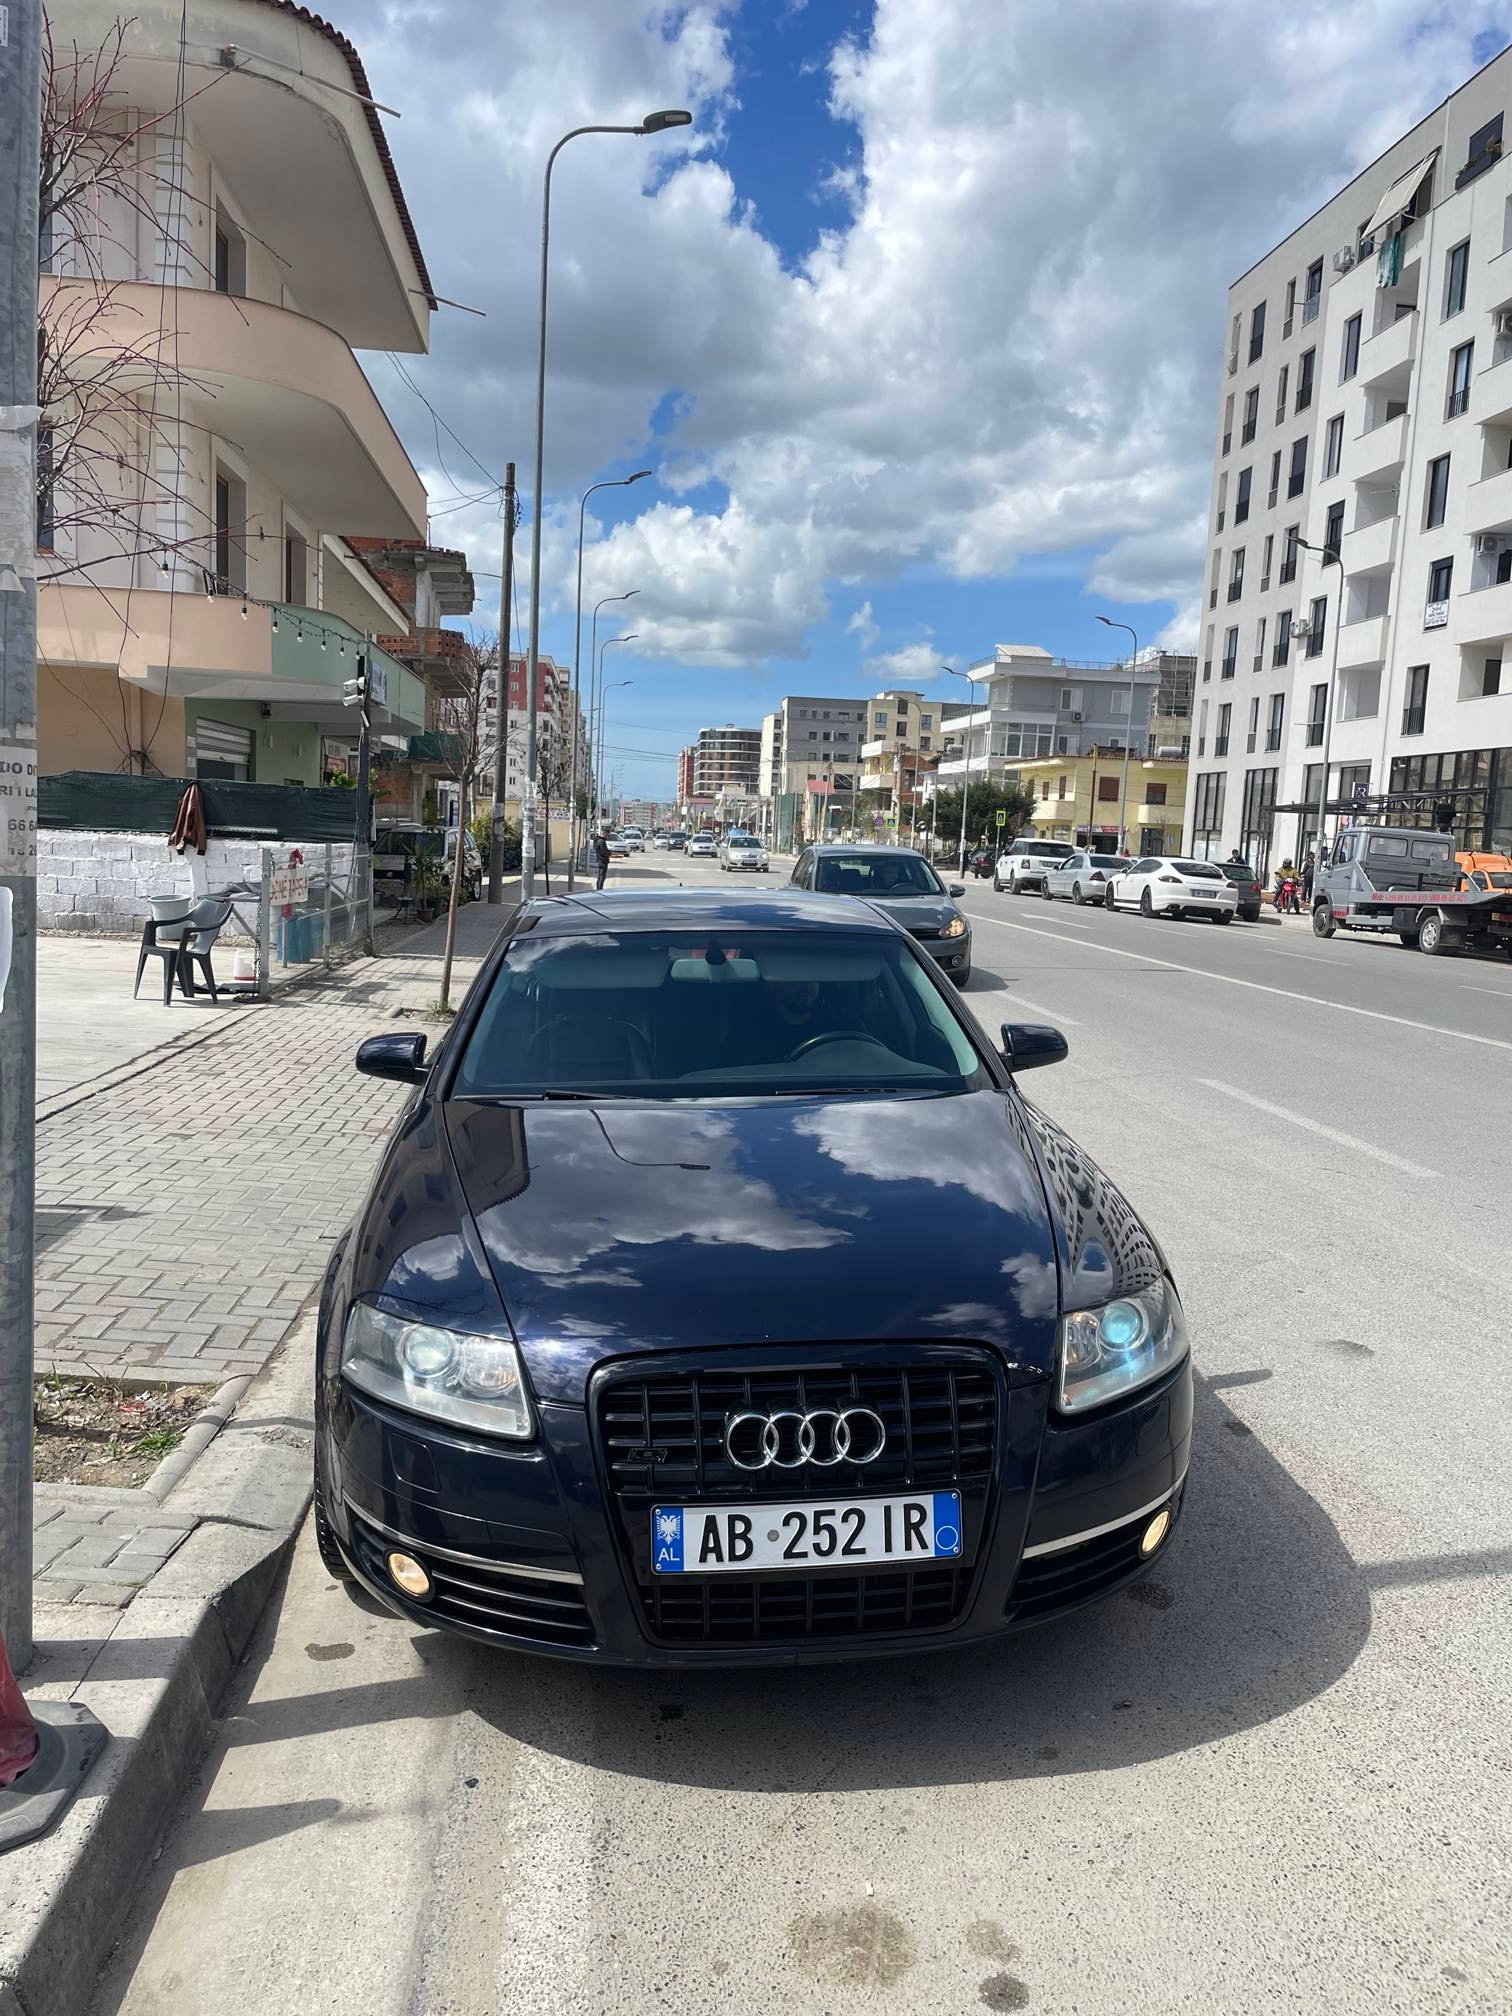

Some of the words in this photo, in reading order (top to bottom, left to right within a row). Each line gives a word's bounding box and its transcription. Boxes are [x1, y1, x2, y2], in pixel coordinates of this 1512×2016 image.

[698, 1513, 754, 1564] AB
[782, 1507, 867, 1560] 252
[883, 1502, 929, 1553] IR
[658, 1547, 680, 1561] AL
